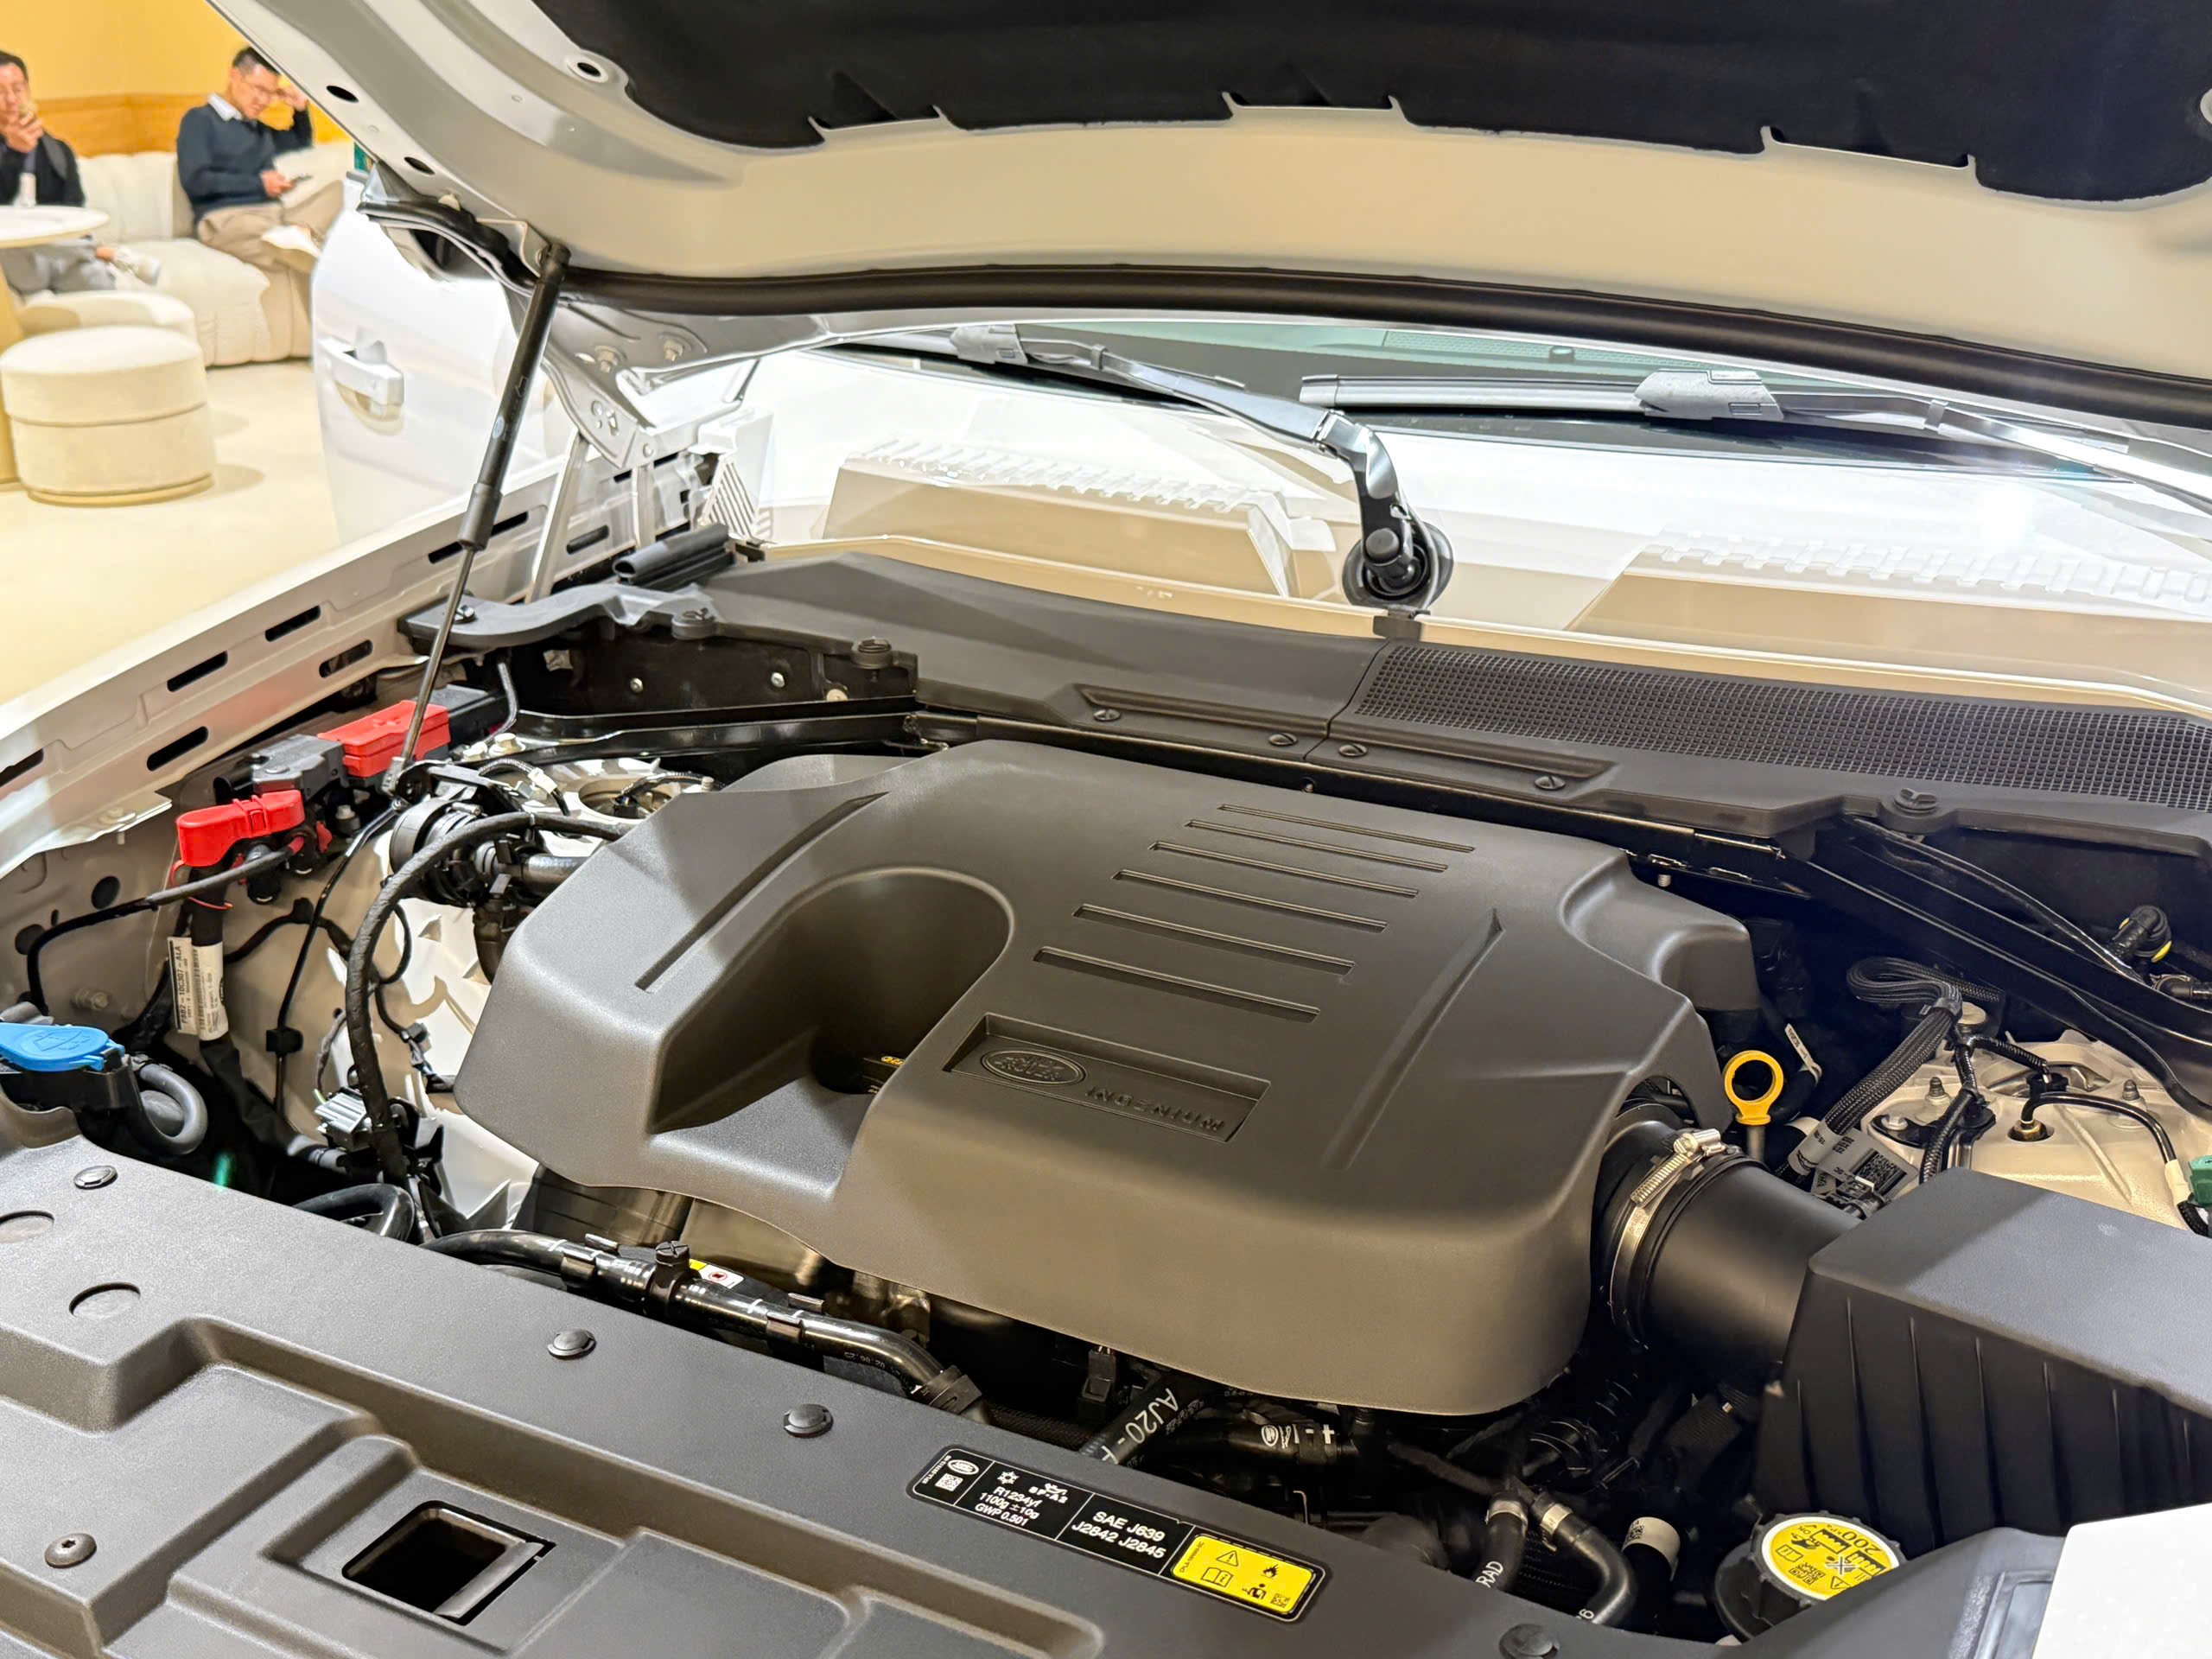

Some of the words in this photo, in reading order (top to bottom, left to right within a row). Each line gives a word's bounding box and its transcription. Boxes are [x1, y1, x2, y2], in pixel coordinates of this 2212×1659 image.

[1085, 1086, 1224, 1132] INGENIUM
[979, 1492, 1010, 1510] 1100g
[993, 1486, 1043, 1508] R1234yf
[975, 1503, 1002, 1516] GWP
[1001, 1512, 1029, 1527] 0.501
[1092, 1511, 1128, 1529] SAE
[1126, 1523, 1166, 1542] J639
[1071, 1521, 1119, 1543] J2842
[1117, 1536, 1166, 1559] J2845
